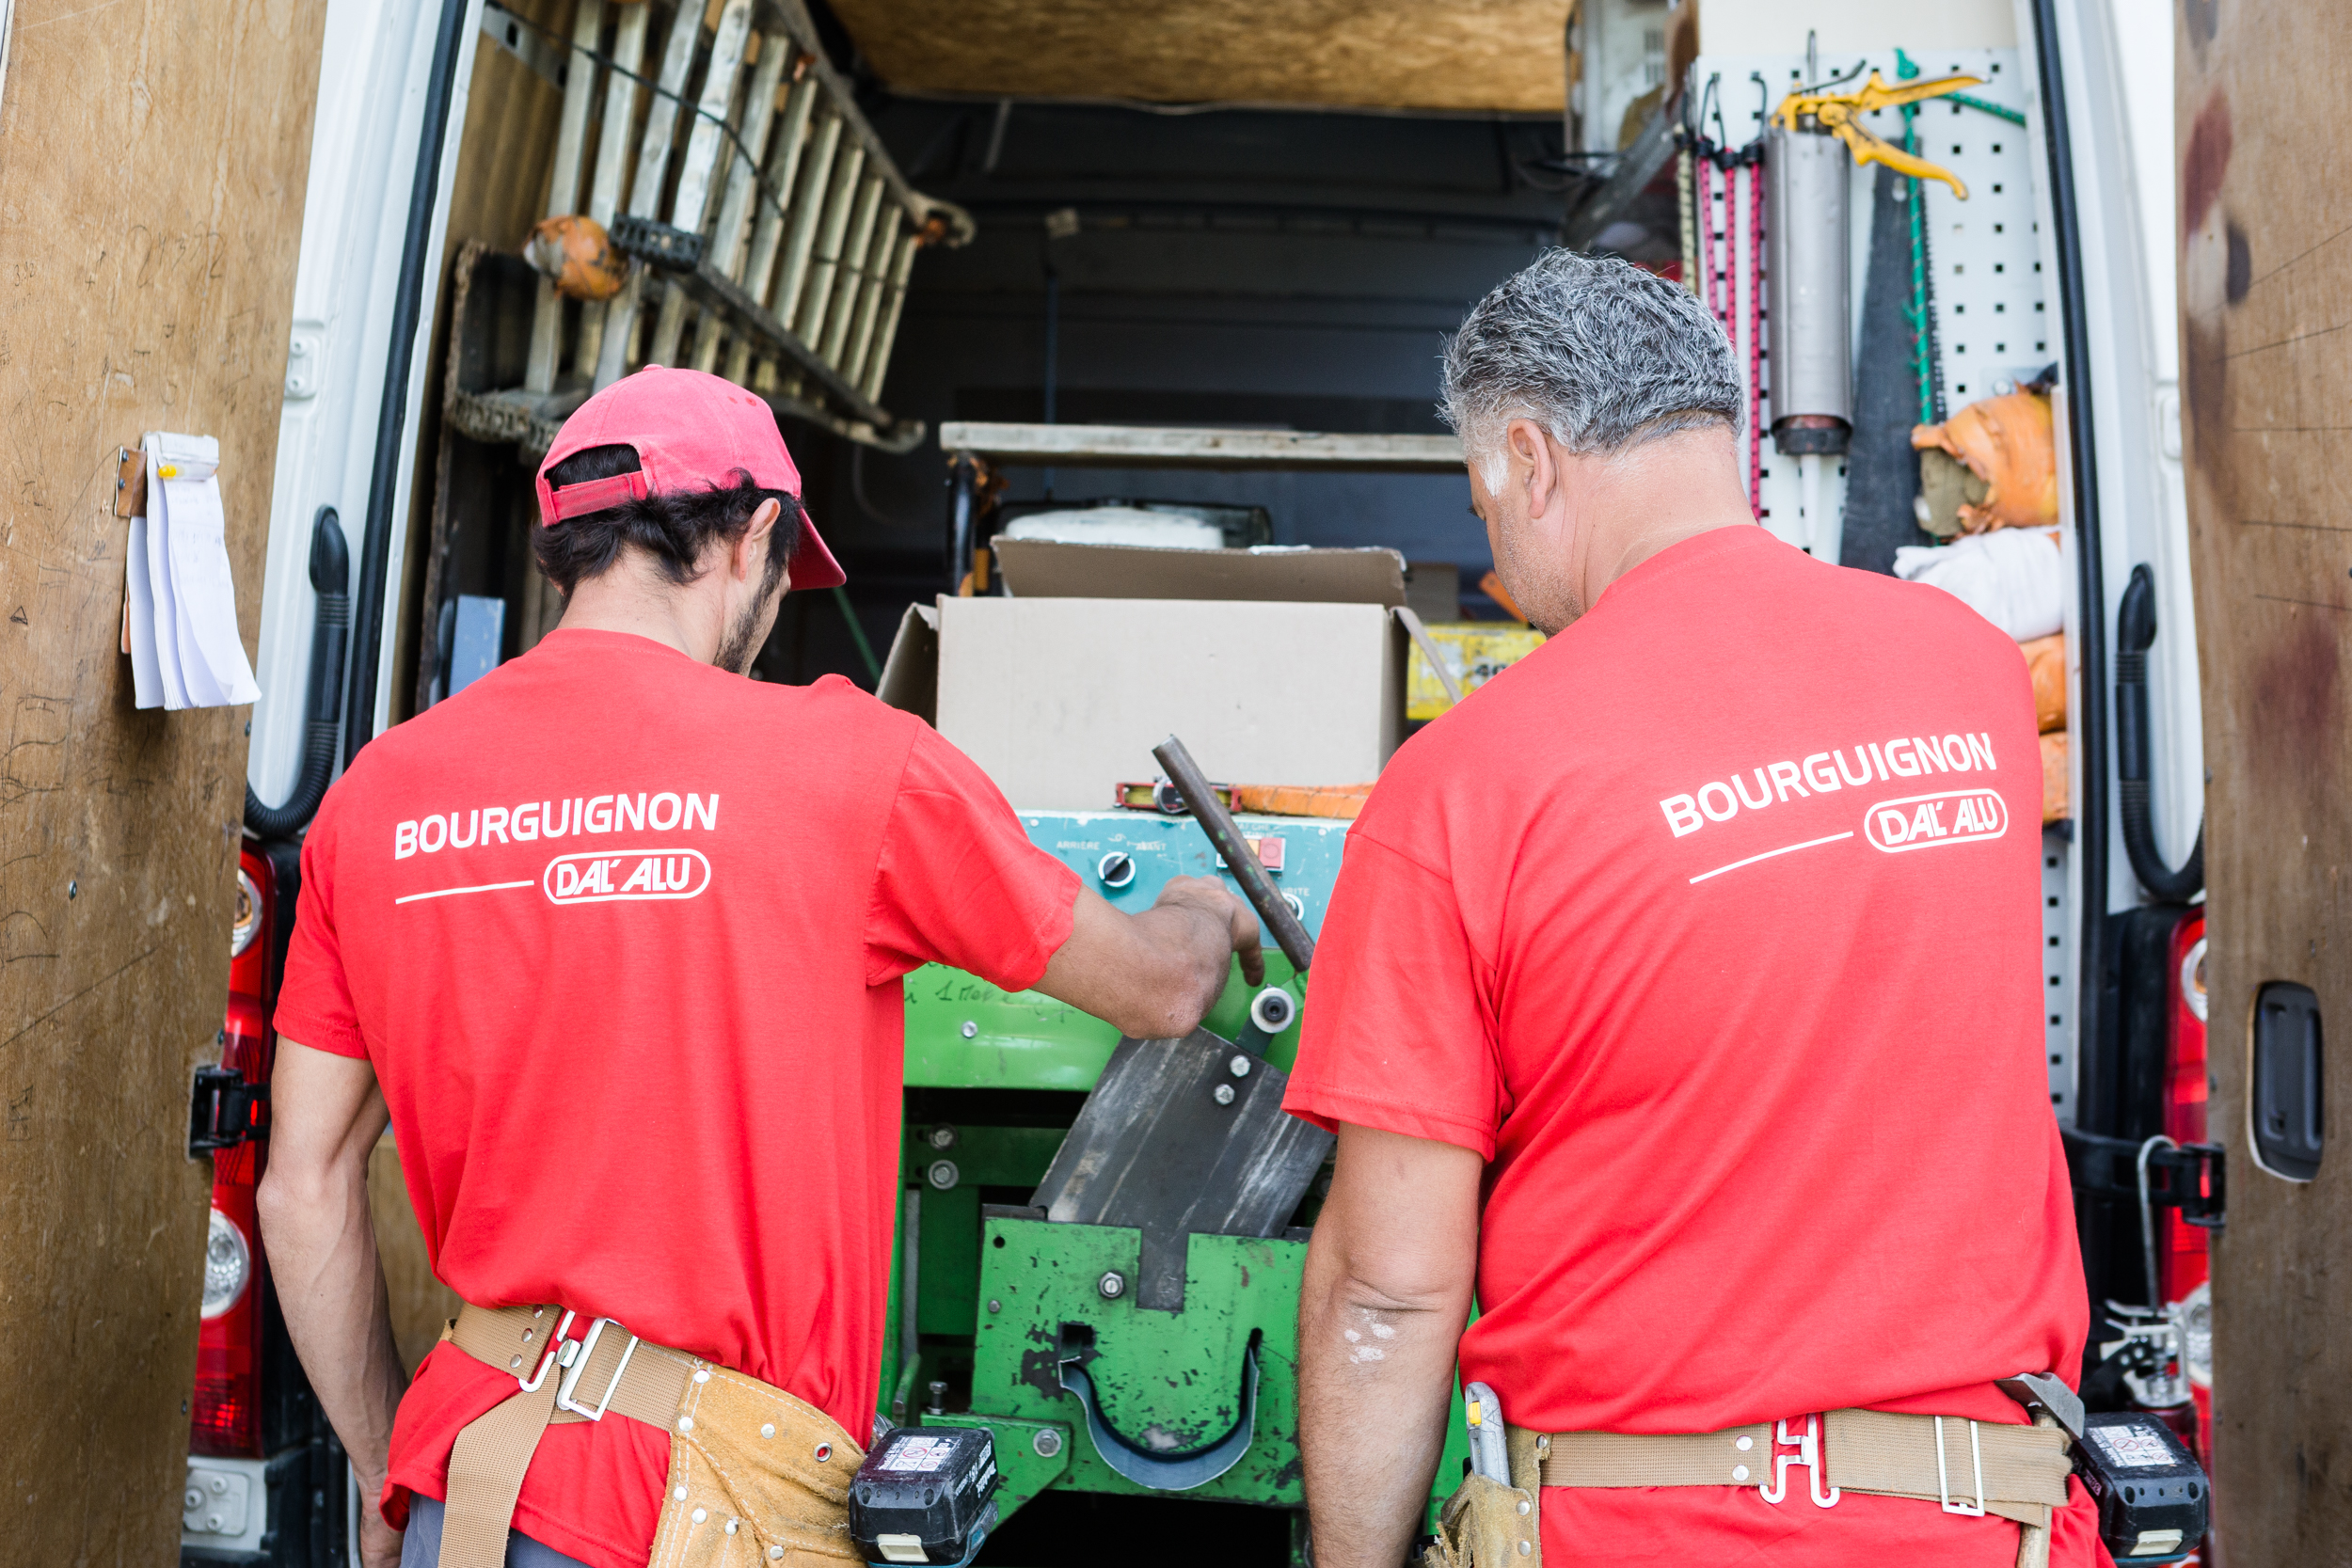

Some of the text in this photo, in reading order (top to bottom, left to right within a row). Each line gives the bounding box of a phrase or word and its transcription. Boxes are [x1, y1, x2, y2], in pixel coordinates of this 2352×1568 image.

[1659, 732, 1997, 839] BOURGUIGNON
[394, 791, 720, 861] BOURGUIGNON
[1951, 796, 1998, 834] ALU
[619, 857, 691, 892] ALU
